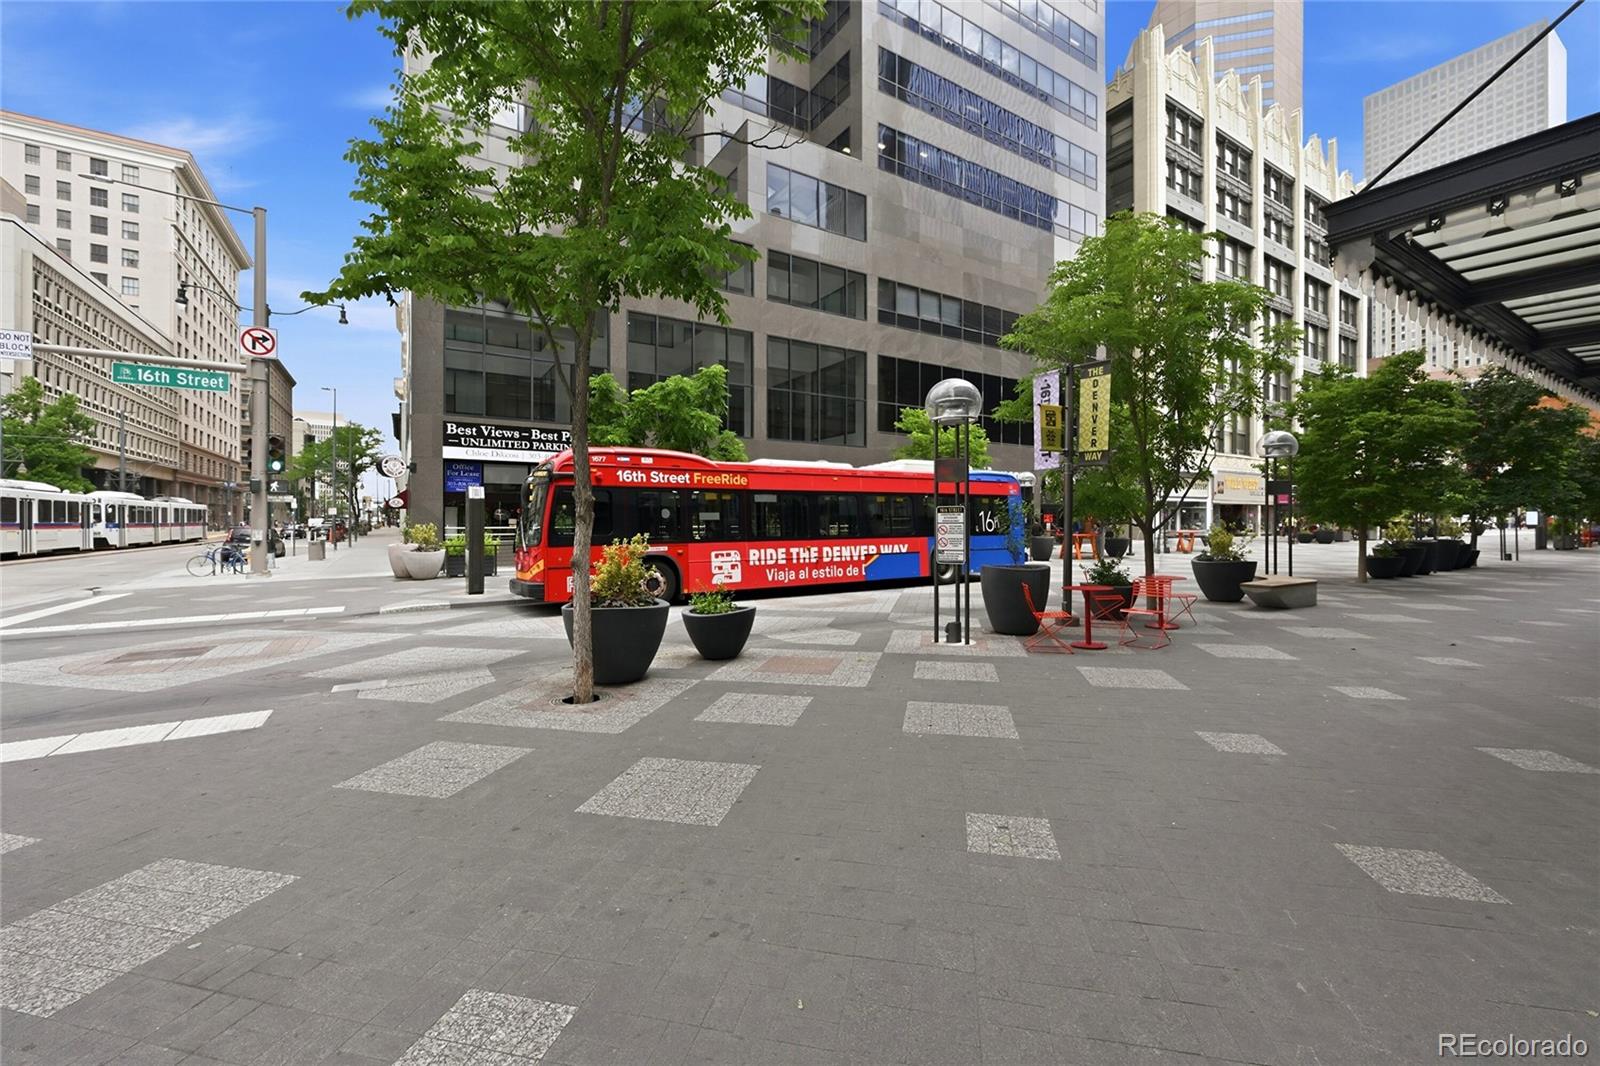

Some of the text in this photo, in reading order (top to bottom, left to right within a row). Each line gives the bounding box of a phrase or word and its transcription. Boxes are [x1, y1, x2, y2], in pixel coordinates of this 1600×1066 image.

[13, 334, 30, 342] NOT
[0, 342, 31, 351] BLOCK
[137, 368, 225, 389] 16th Street
[1087, 366, 1104, 377] THE
[1090, 379, 1099, 448] DENVER
[446, 422, 478, 436] Best
[480, 425, 520, 439] Views
[531, 429, 559, 441] Best
[460, 437, 531, 449] UNLIMITED
[532, 441, 572, 451] PARKIN
[1084, 451, 1103, 461] WAY
[452, 463, 474, 471] Office
[616, 469, 748, 485] 16th Street FreeRide
[749, 547, 787, 566] RIDE
[789, 546, 819, 564] THE
[766, 568, 796, 583] Viaja
[798, 566, 809, 579] al
[811, 564, 844, 579] estilo
[846, 564, 859, 577] de
